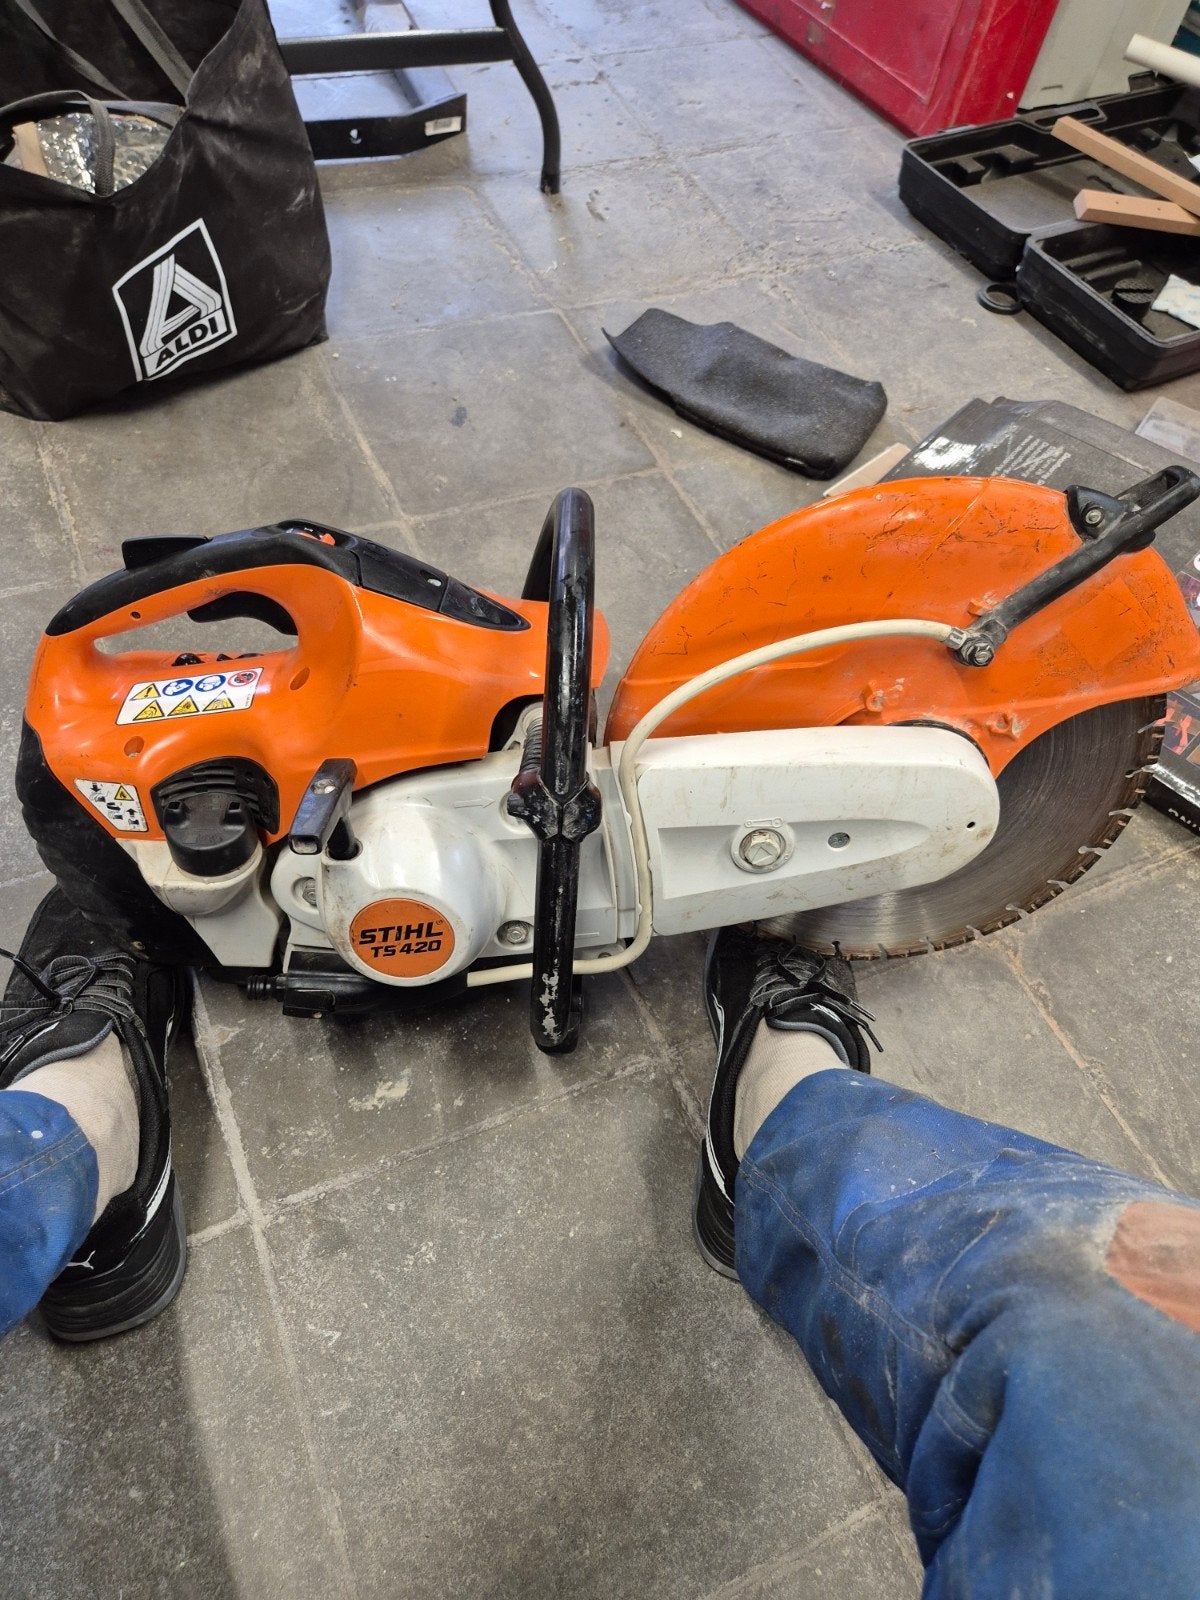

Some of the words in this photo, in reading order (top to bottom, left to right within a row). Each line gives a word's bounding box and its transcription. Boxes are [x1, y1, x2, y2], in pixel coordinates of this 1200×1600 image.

[156, 316, 219, 369] ALDI
[359, 922, 443, 945] STIHL
[371, 945, 397, 958] TS
[399, 940, 442, 954] 420
